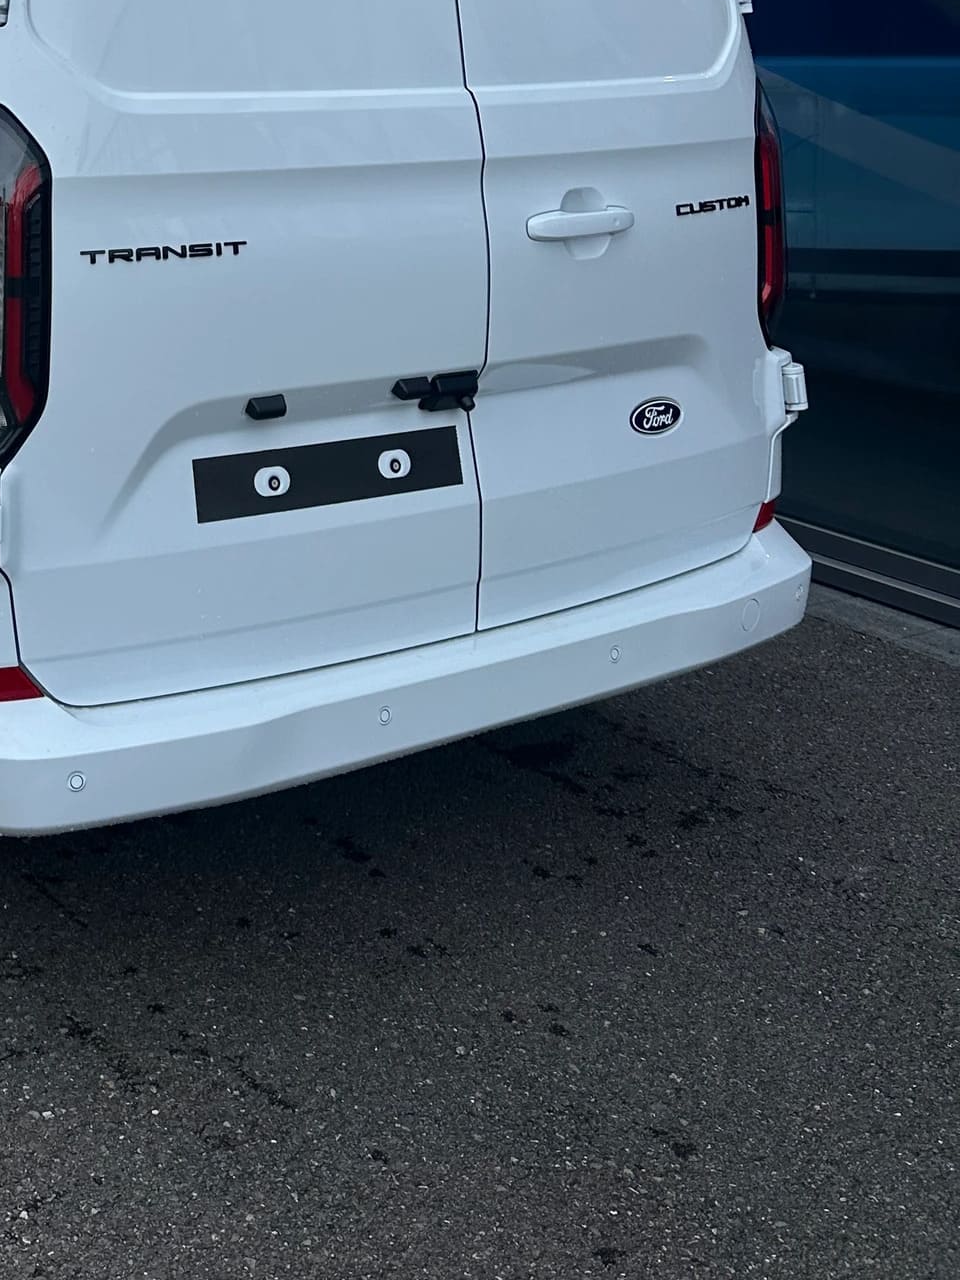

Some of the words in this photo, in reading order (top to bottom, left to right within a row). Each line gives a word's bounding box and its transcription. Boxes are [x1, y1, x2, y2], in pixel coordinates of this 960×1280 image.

[676, 195, 750, 216] CUSTOM
[80, 240, 247, 265] TRANSIT
[642, 406, 674, 429] Ford
